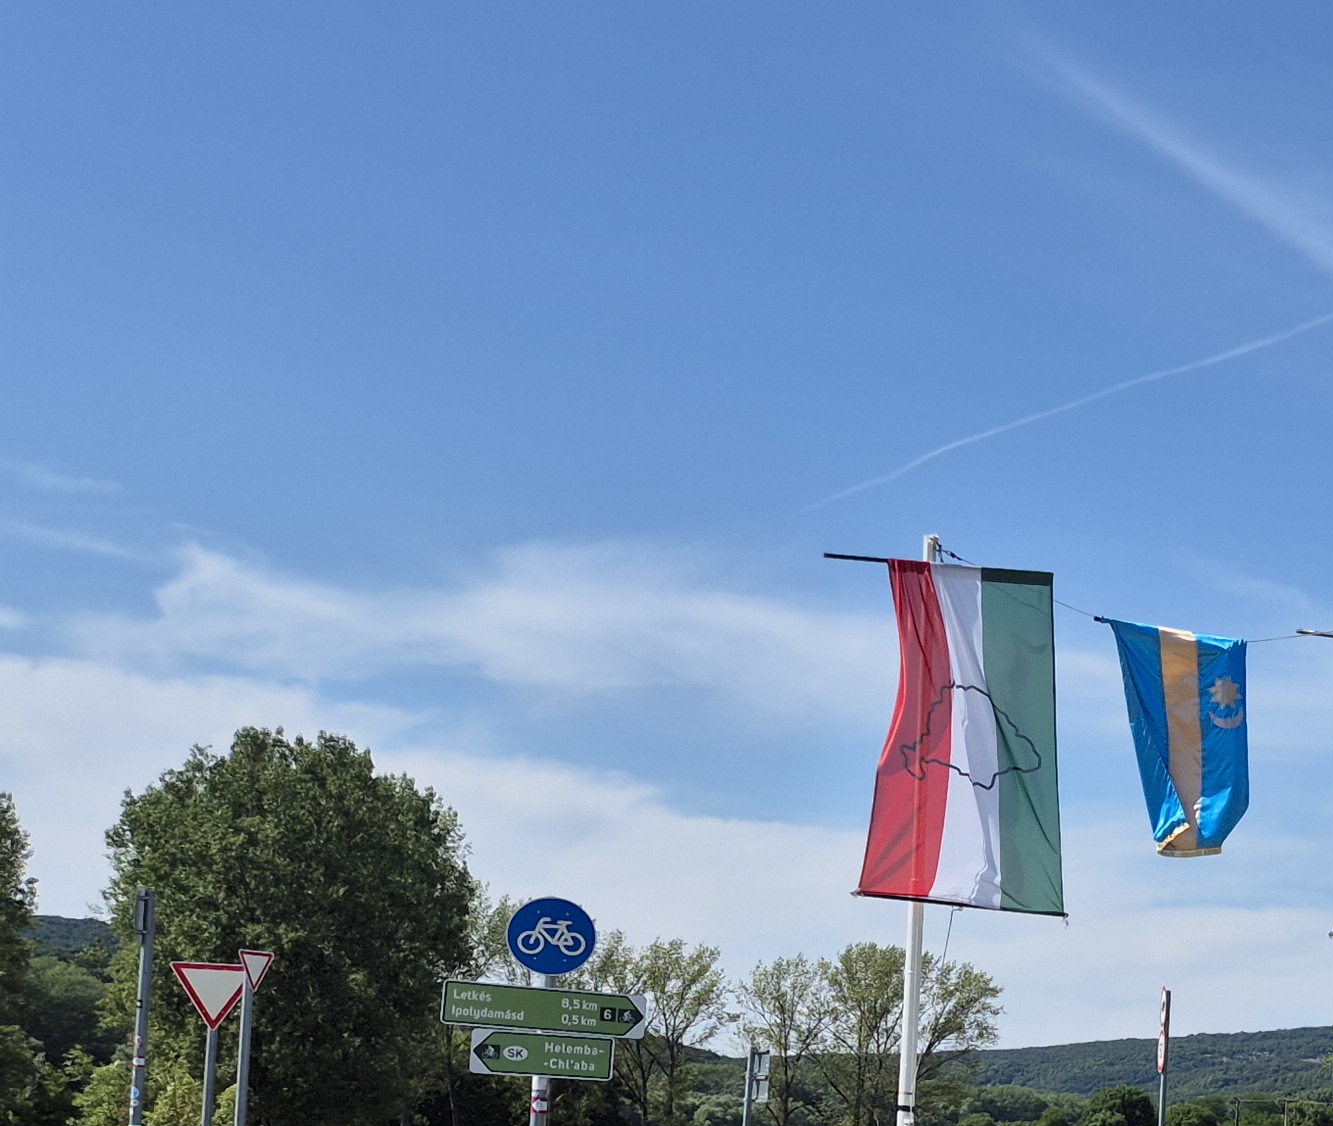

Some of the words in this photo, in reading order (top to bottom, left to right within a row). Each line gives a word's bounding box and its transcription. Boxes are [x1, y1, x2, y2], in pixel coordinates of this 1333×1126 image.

[453, 988, 492, 1003] Letkés
[561, 998, 580, 1011] 8,5
[582, 999, 598, 1011] km
[451, 1004, 524, 1022] Ipolydamásd
[603, 1009, 612, 1020] 6
[561, 1014, 580, 1027] 0,5
[581, 1016, 597, 1027] km
[506, 1048, 524, 1059] SK
[544, 1042, 605, 1056] Helemba-
